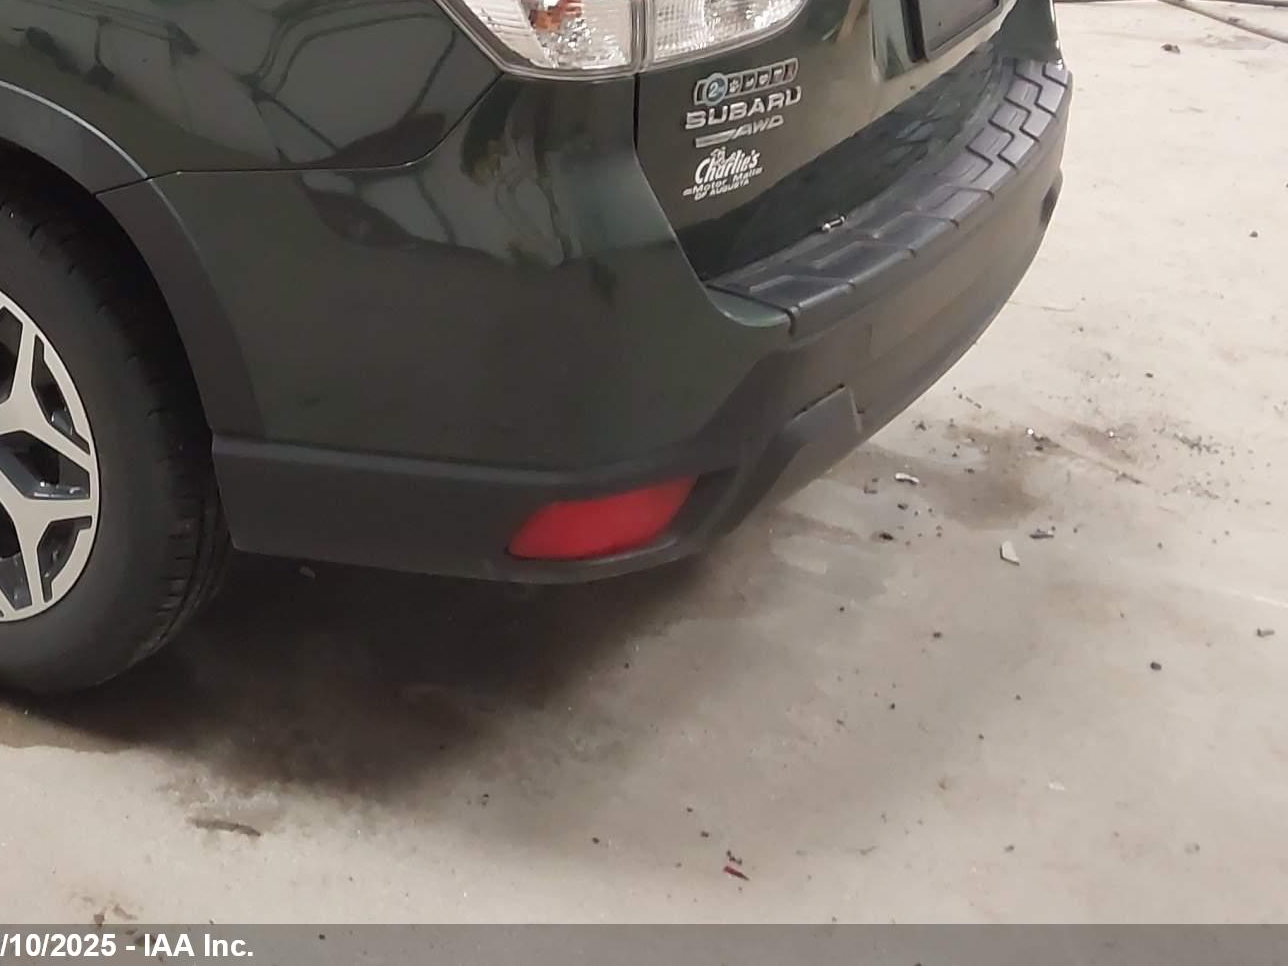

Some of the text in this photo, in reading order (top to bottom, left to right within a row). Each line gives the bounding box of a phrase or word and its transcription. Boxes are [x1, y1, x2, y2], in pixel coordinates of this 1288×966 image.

[685, 86, 802, 130] SUBARU
[733, 114, 784, 140] AWD
[694, 149, 761, 185] Charlie's
[692, 179, 727, 194] Motor
[709, 178, 750, 196] AUGUSTA
